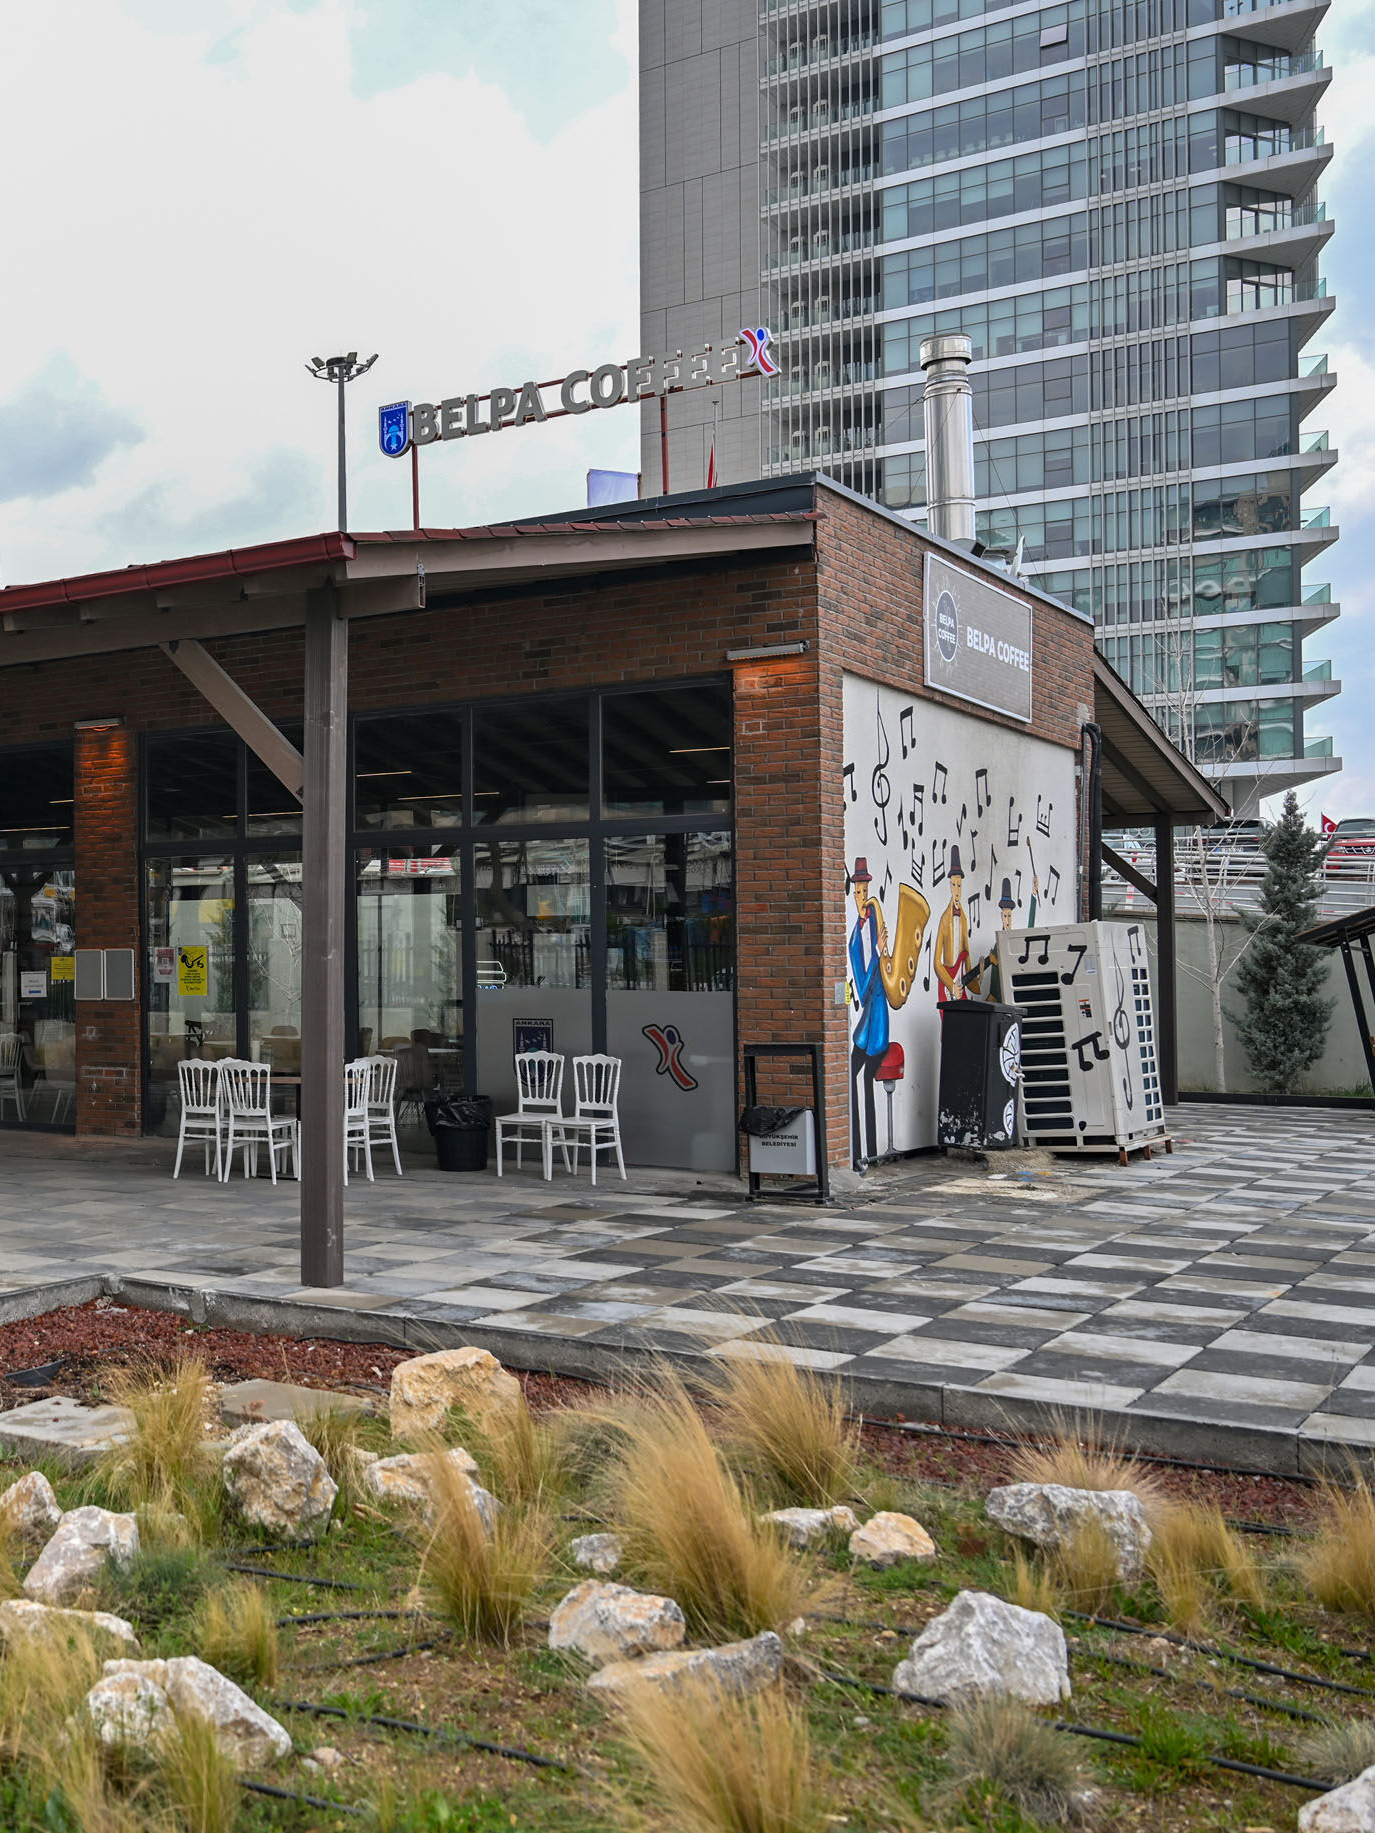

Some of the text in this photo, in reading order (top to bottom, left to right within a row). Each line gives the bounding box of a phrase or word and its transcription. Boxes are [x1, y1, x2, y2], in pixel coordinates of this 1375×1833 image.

[413, 336, 743, 445] BELPA COFFEE
[938, 628, 956, 645] COFFEE
[939, 612, 955, 629] BELPA
[966, 625, 1030, 672] BELPA COFFEE
